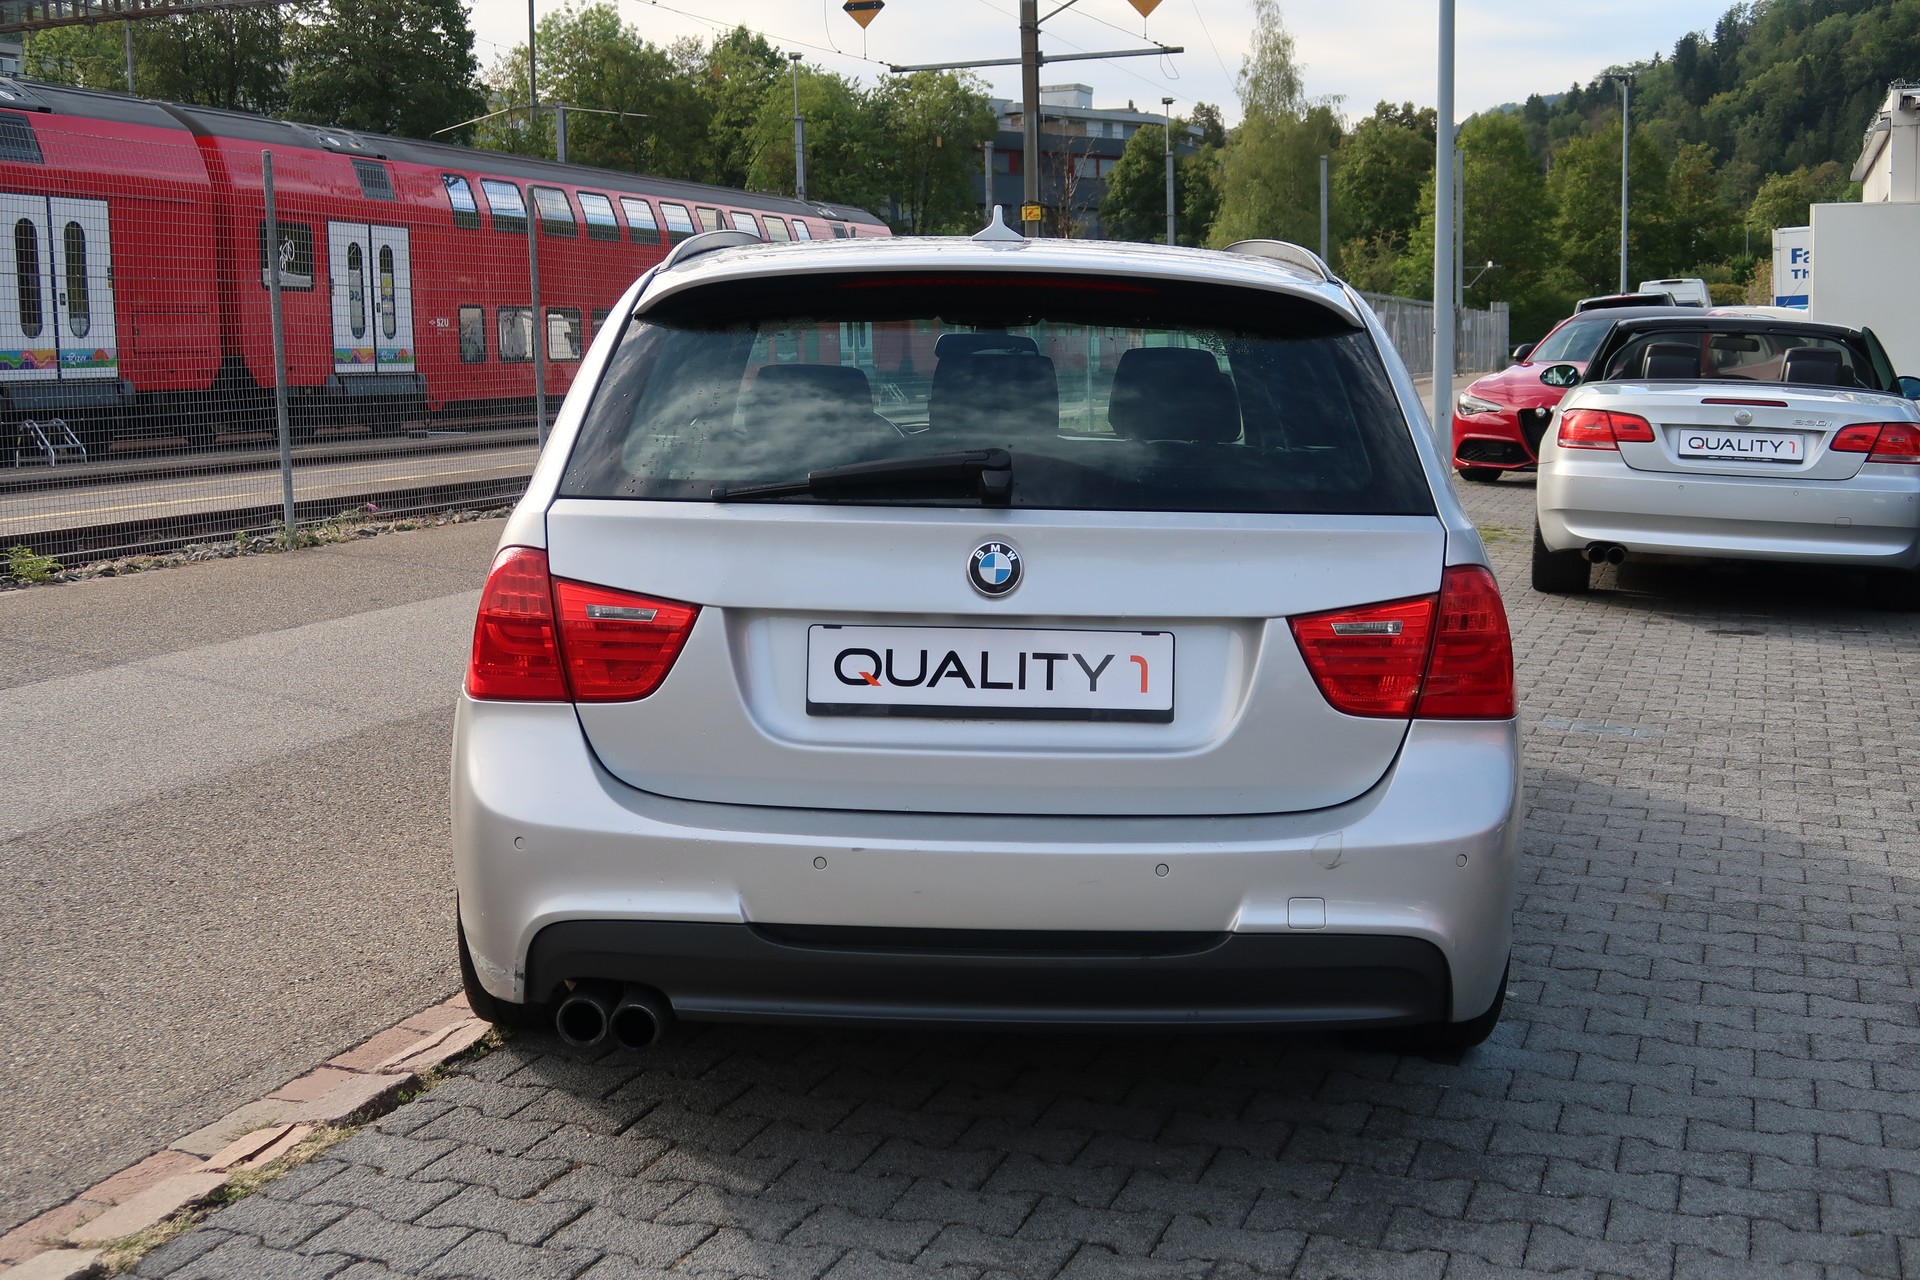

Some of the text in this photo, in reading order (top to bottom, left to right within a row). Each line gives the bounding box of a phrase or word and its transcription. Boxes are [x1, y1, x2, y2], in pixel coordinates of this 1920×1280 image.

[1688, 436, 1796, 454] QUALITY 1
[975, 544, 1017, 561] BMW
[834, 647, 1149, 693] QUALITY 1
